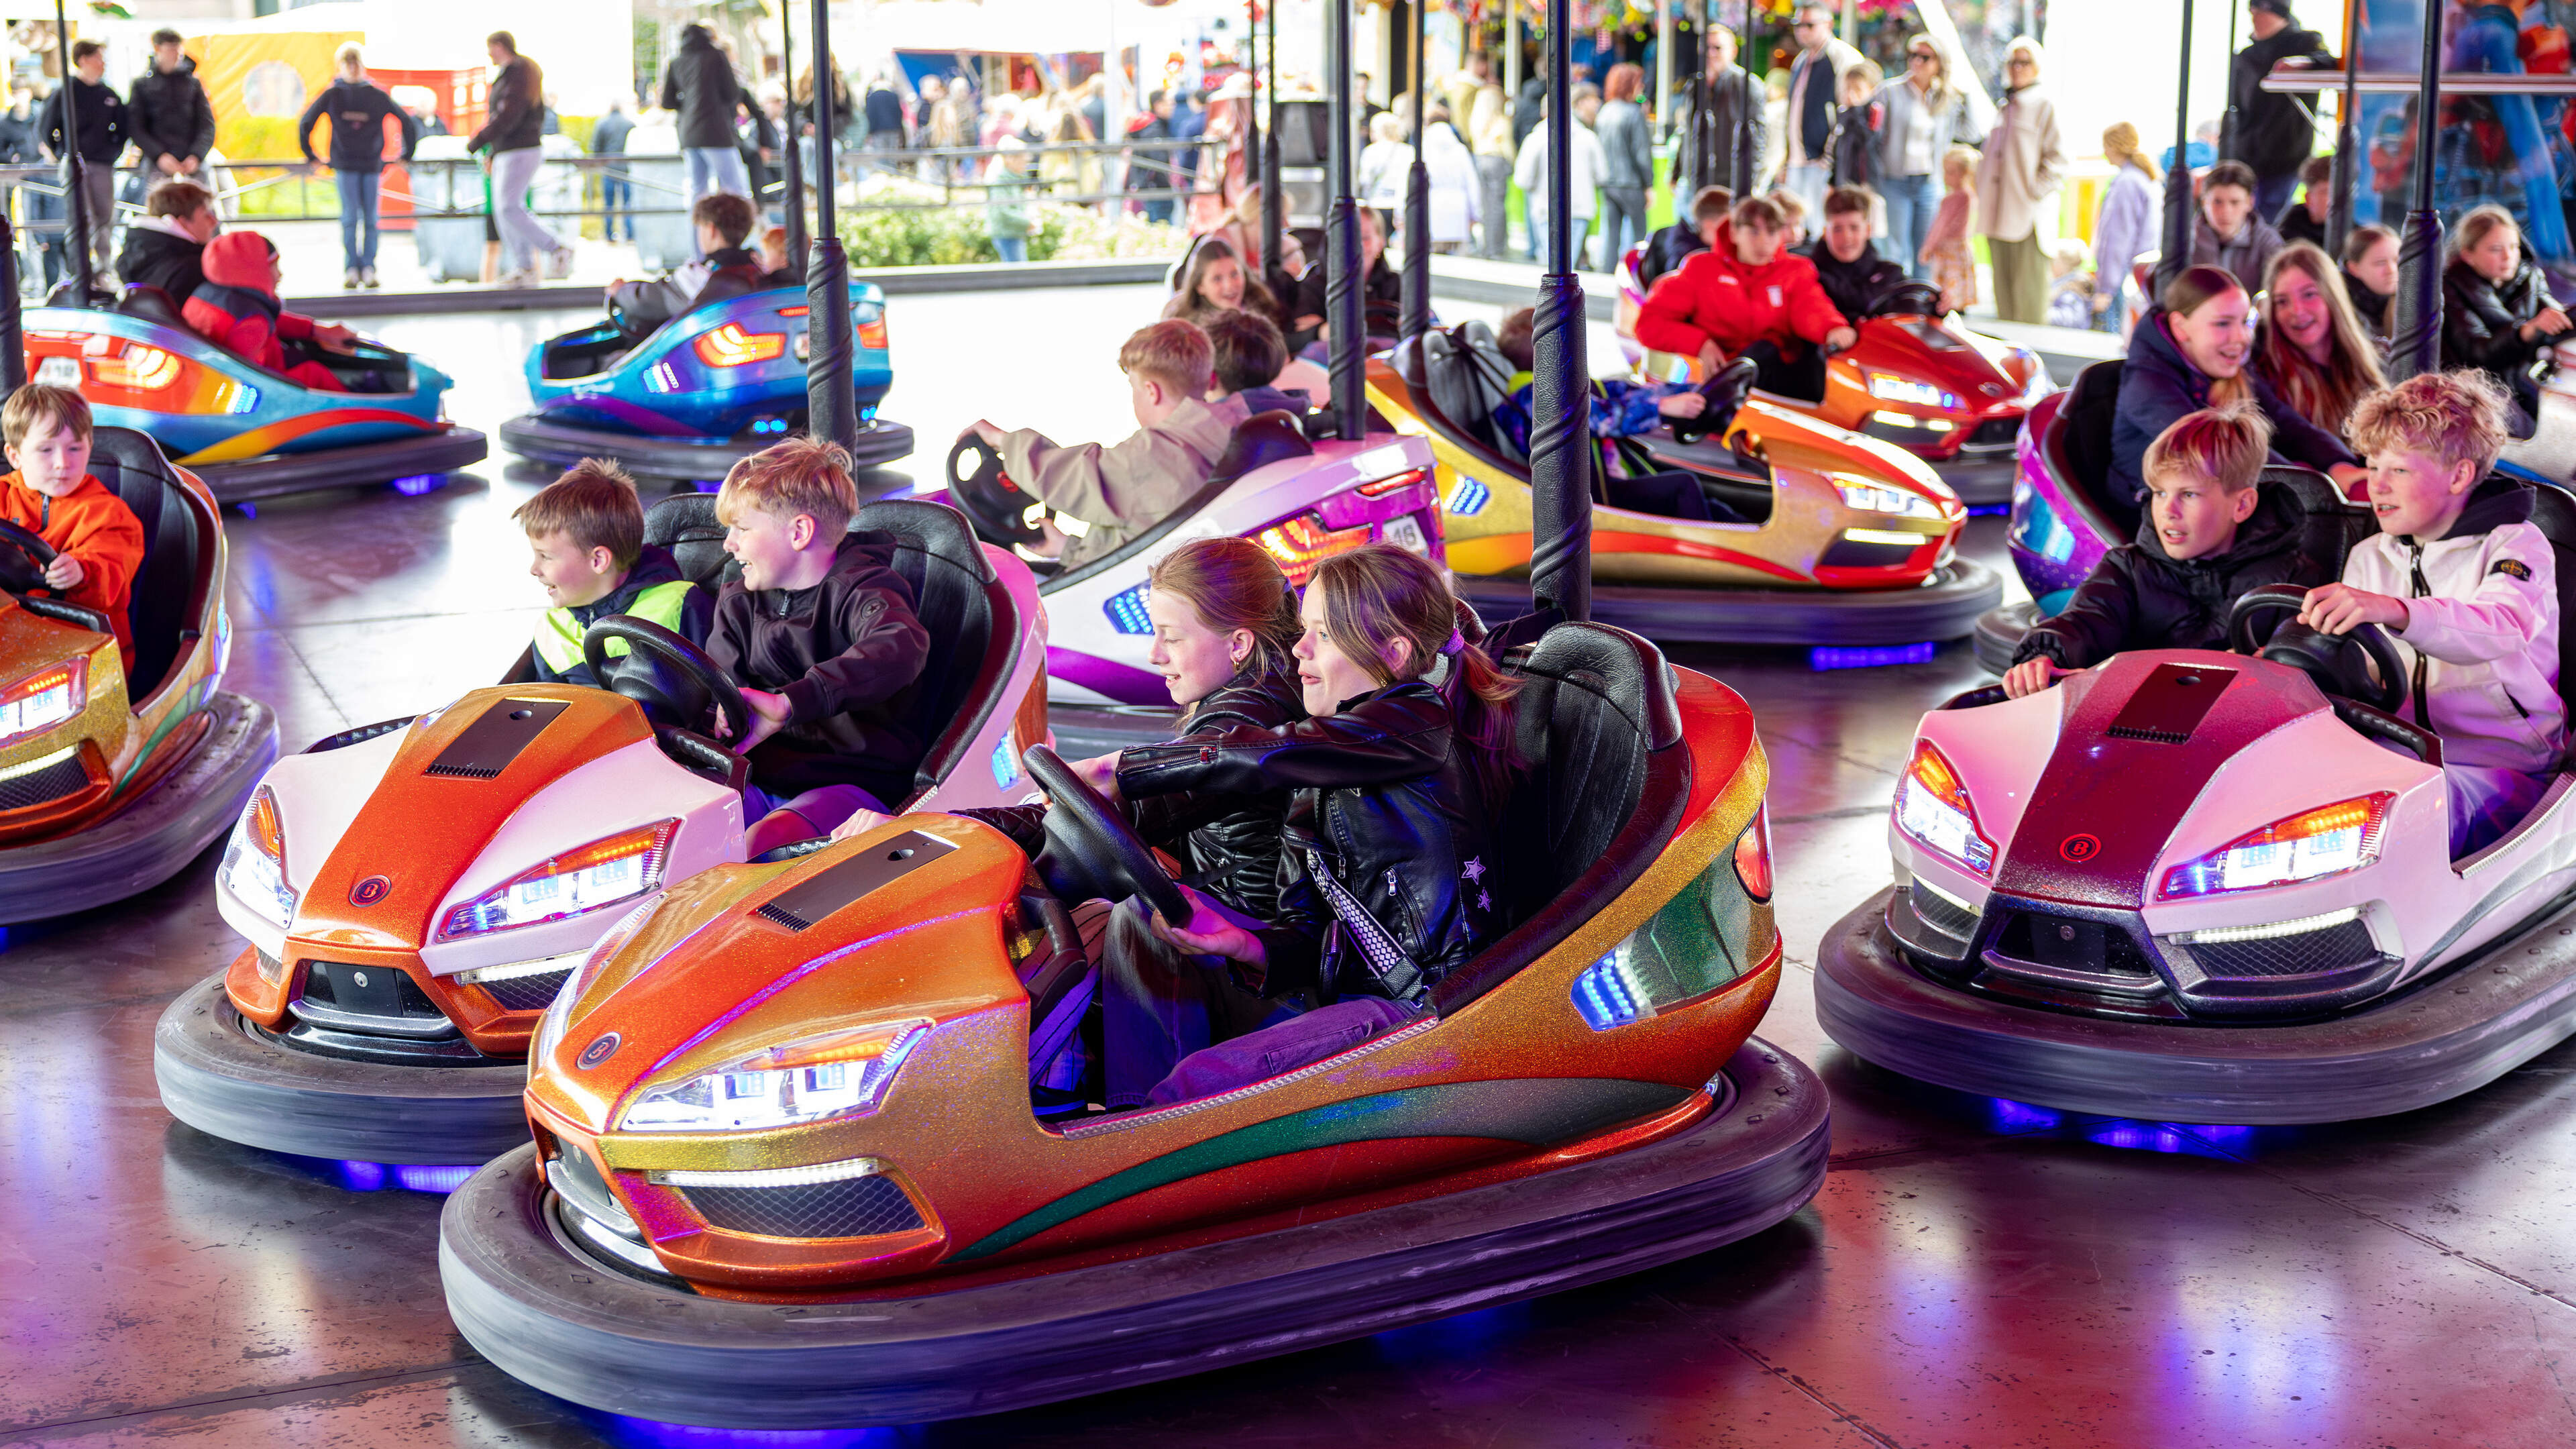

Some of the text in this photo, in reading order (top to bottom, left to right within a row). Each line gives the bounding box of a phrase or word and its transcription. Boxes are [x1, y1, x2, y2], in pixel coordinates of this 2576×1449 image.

[2072, 841, 2089, 855] B
[362, 883, 379, 898] B
[588, 1042, 608, 1059] B
